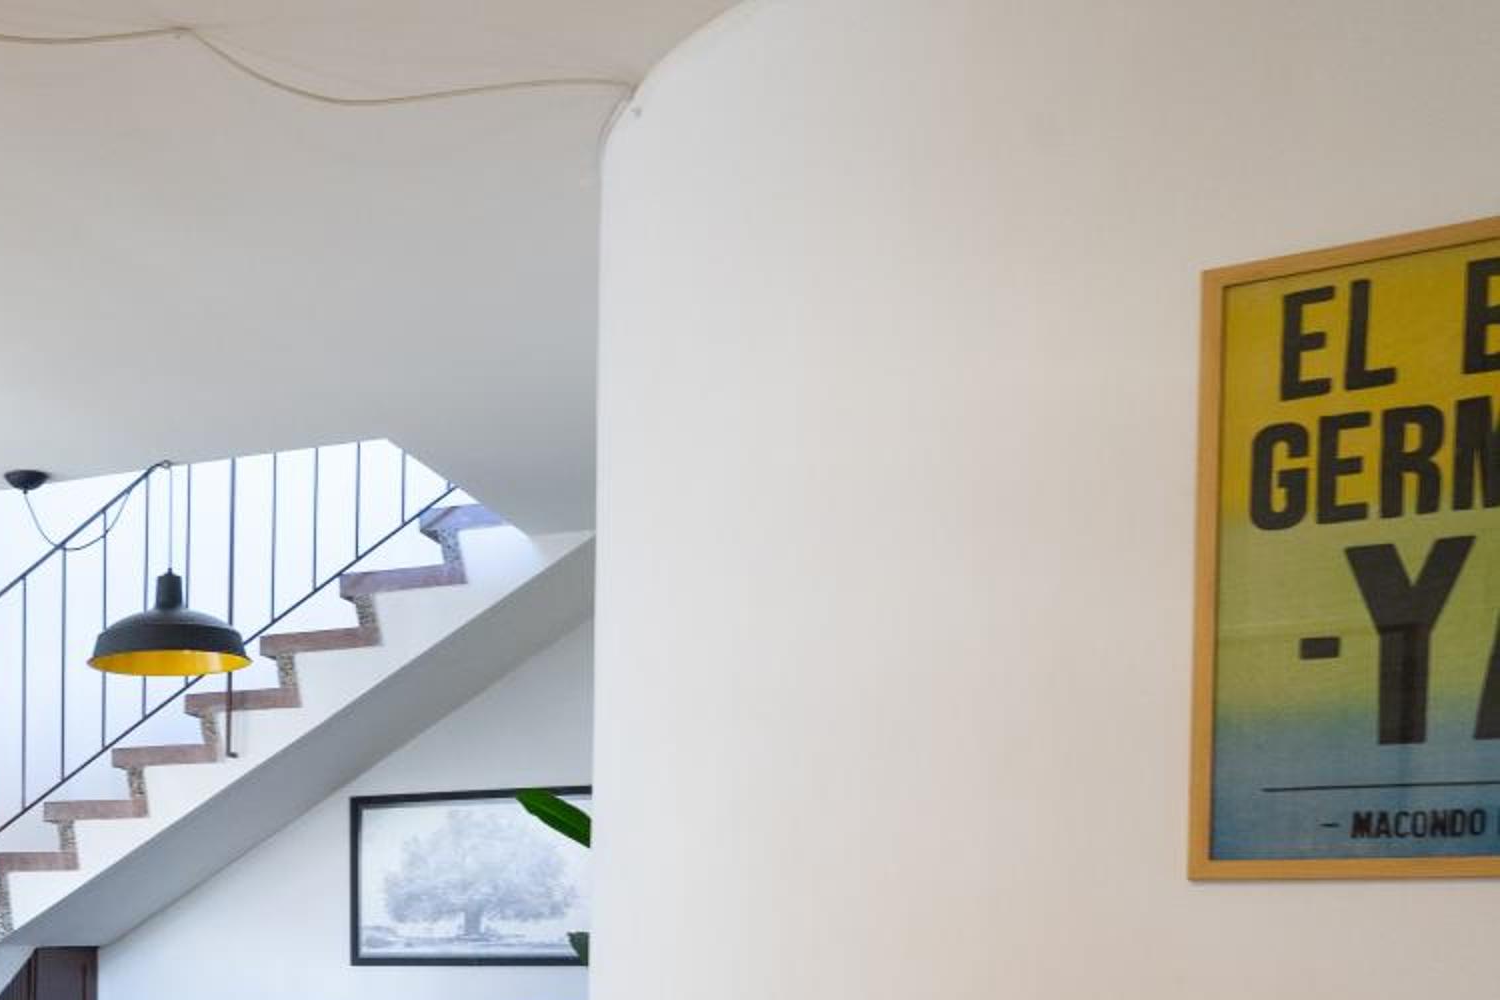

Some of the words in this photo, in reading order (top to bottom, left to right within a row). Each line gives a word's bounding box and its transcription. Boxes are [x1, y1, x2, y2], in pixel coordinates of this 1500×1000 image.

[1279, 279, 1396, 401] EL
[1299, 535, 1500, 745] -Y
[1351, 808, 1487, 838] MACONDO
